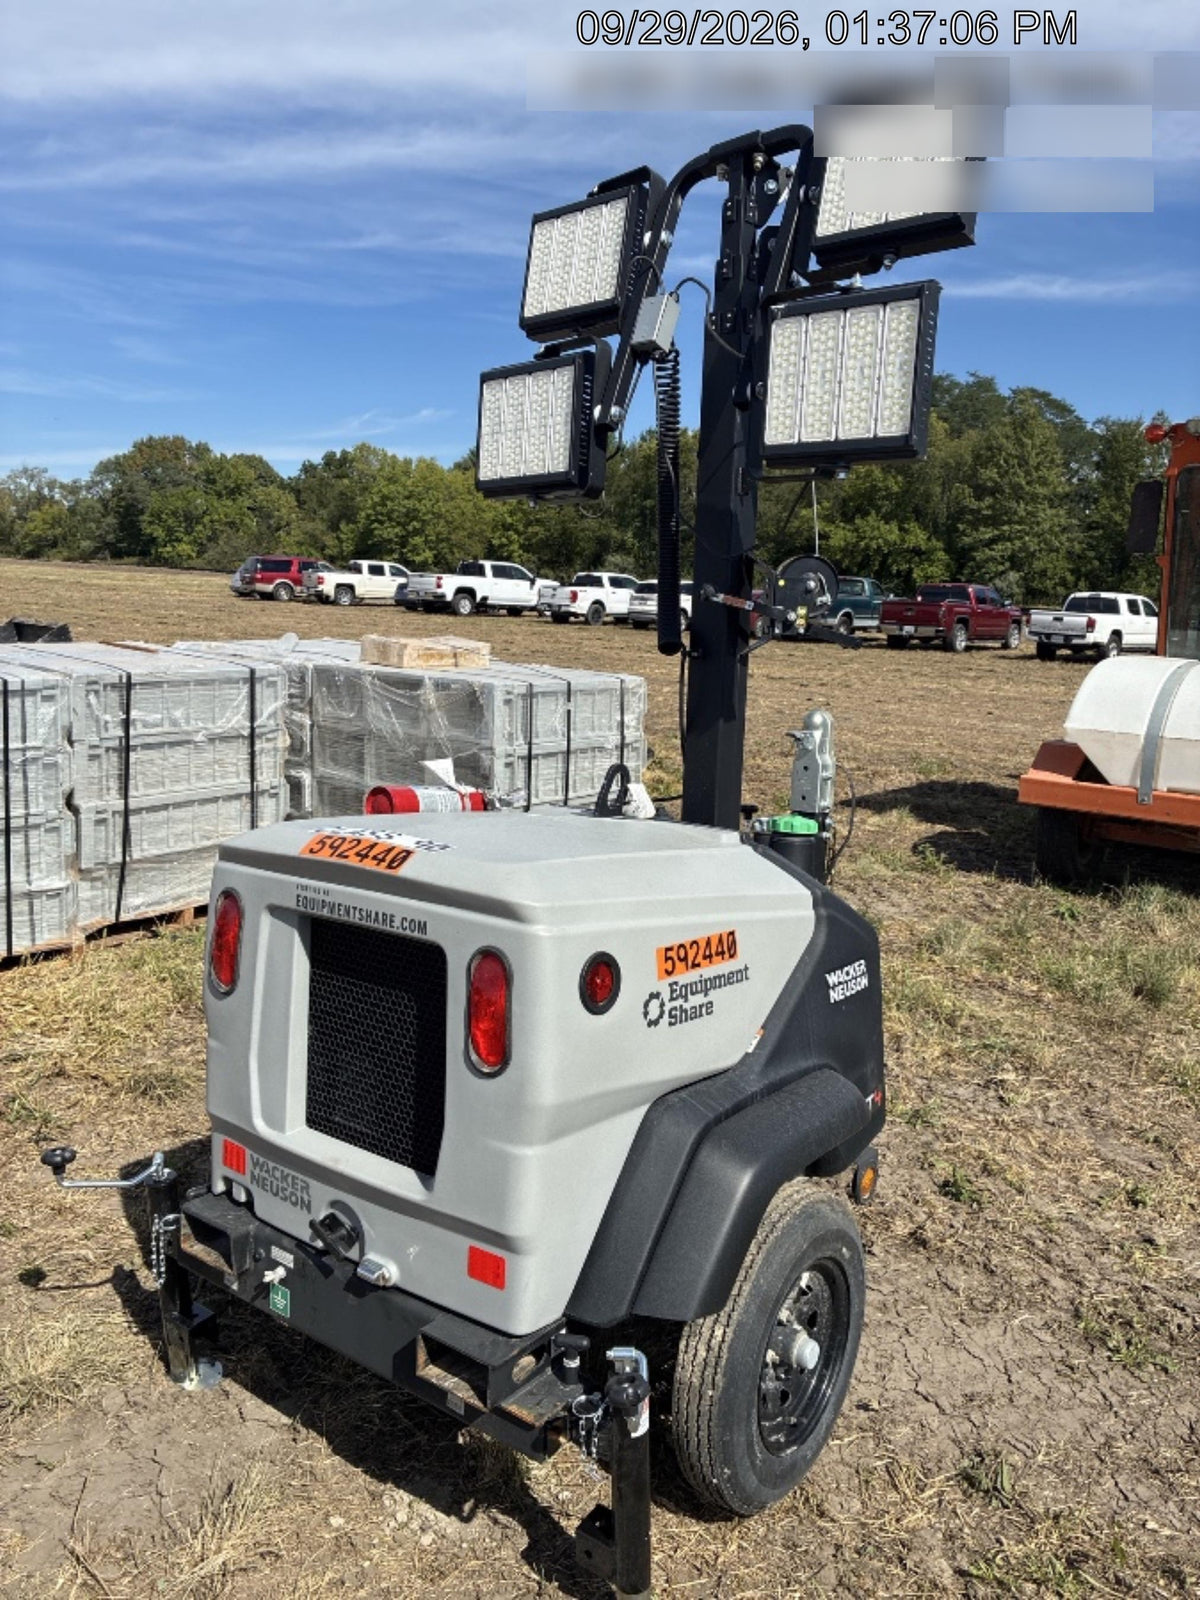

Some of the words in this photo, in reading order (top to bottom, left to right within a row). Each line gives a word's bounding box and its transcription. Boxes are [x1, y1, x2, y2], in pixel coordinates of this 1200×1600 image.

[308, 835, 415, 870] 592440
[296, 894, 428, 936] EQUIPMENTSHARE.COM
[664, 930, 737, 976] 592440
[825, 959, 867, 987] WACKER
[668, 963, 750, 1003] Equipment
[830, 973, 869, 1004] NEUSON
[668, 1000, 714, 1027] Share
[250, 1153, 311, 1199] WACKER
[250, 1171, 312, 1214] NEUSON
